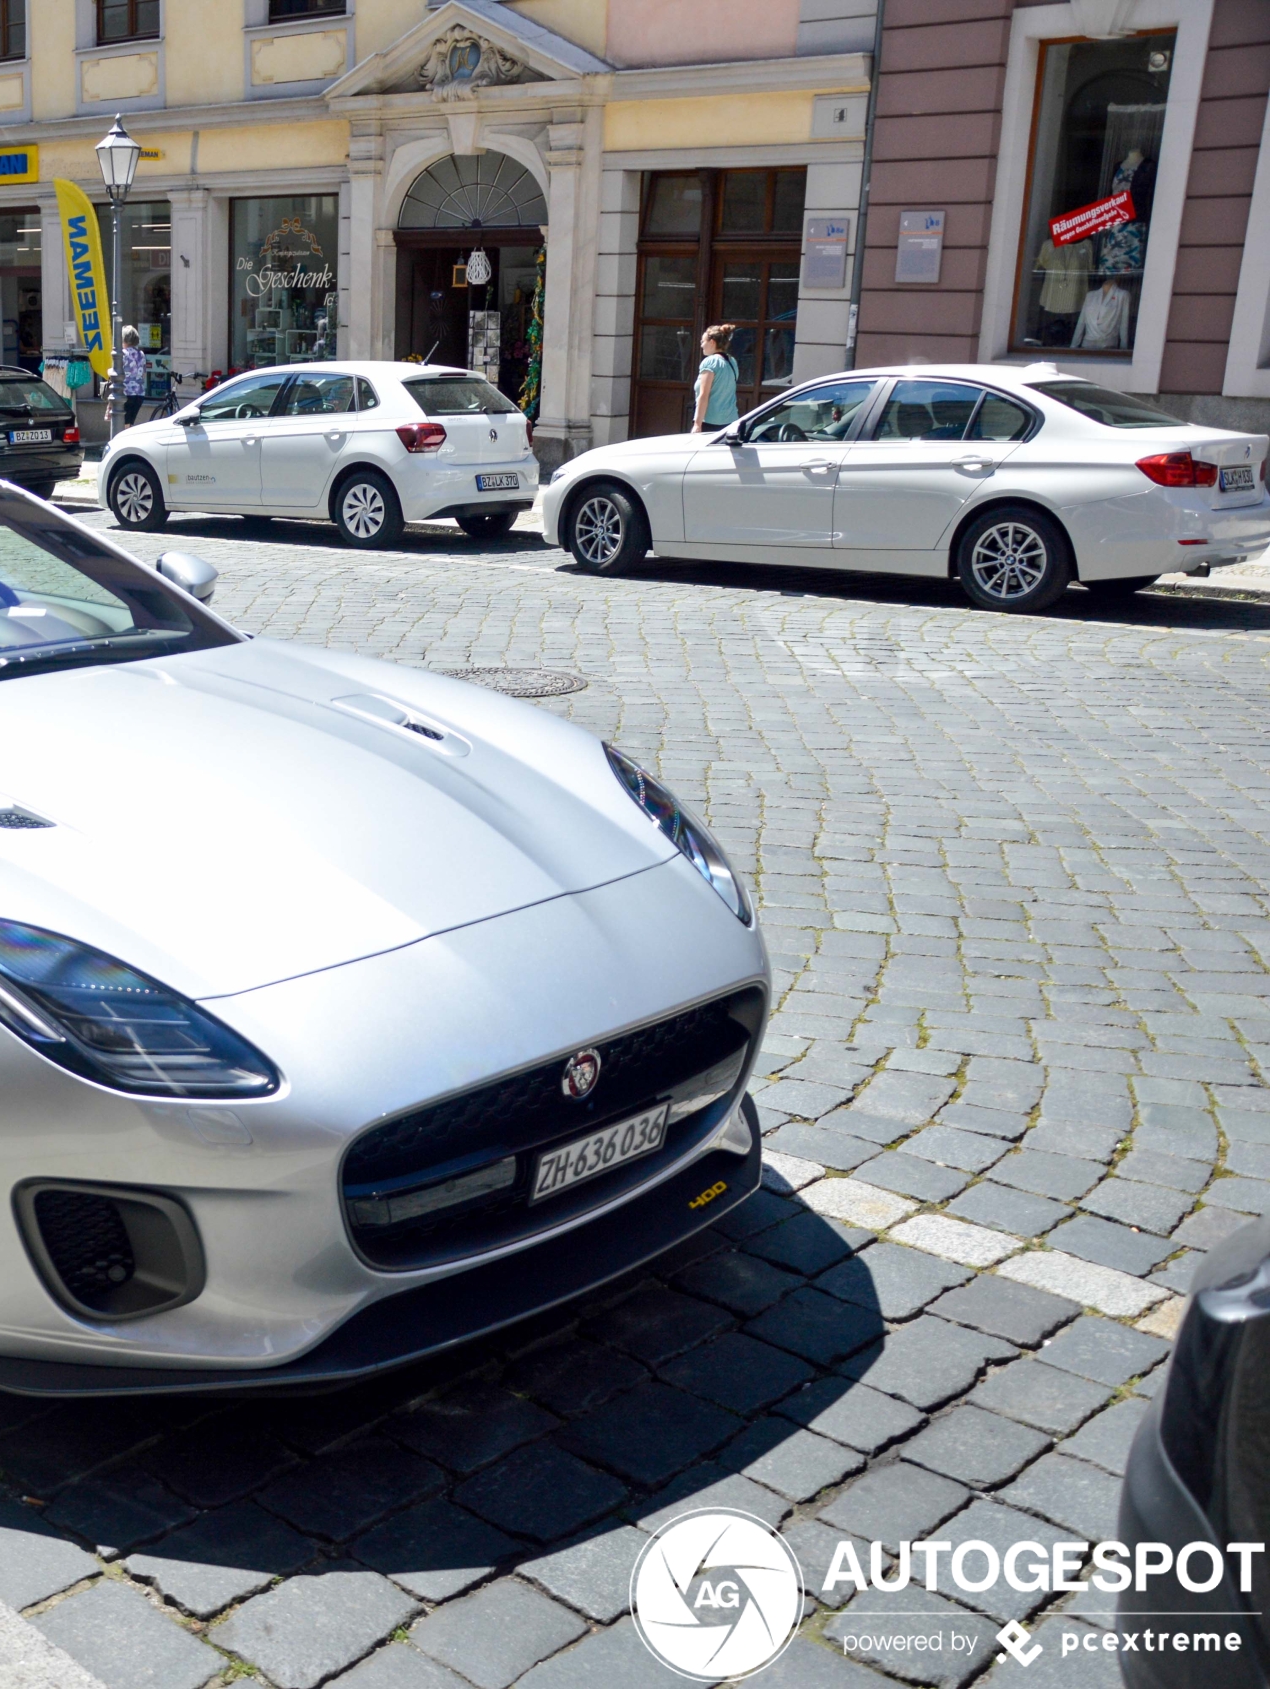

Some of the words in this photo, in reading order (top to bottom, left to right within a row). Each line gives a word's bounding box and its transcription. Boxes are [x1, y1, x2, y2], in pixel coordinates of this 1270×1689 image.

[1052, 192, 1128, 236] Räumungsverkauf
[236, 257, 254, 270] Die
[16, 432, 26, 441] BZ
[40, 430, 49, 440] 13
[482, 476, 491, 488] BZ
[506, 475, 518, 486] 370
[688, 1181, 728, 1209] 400
